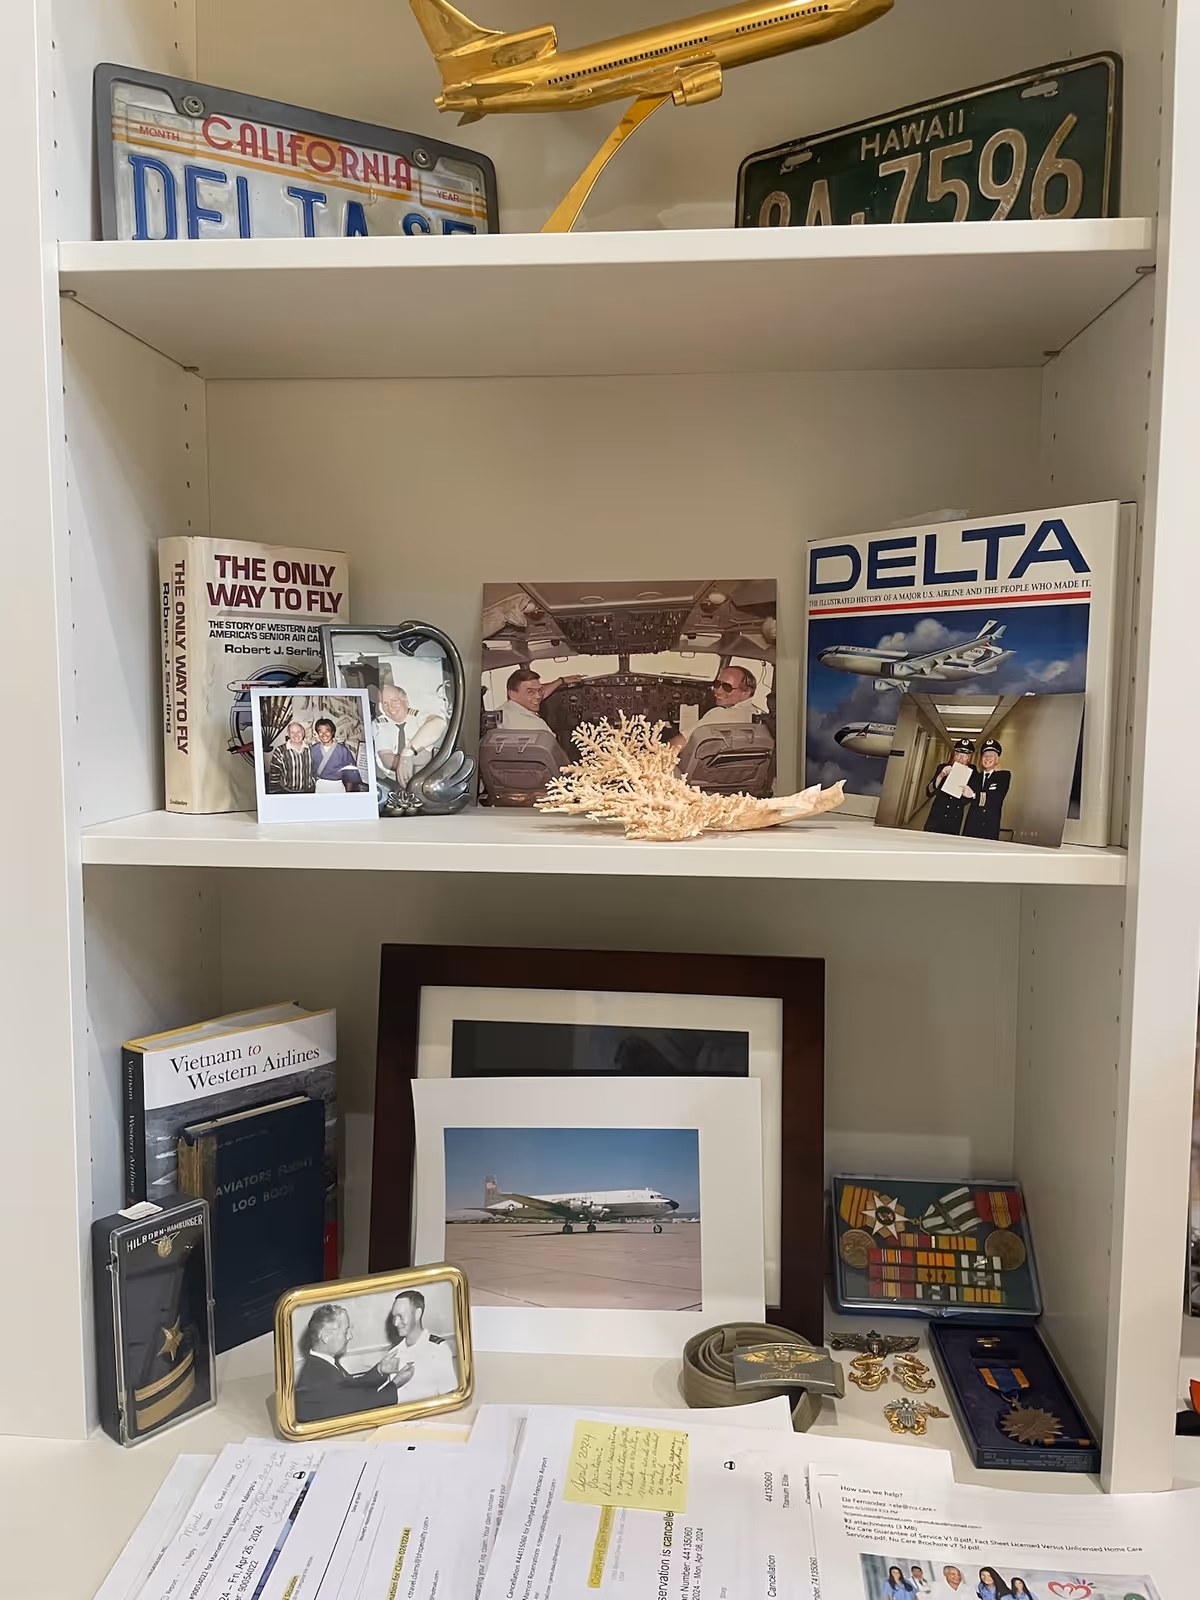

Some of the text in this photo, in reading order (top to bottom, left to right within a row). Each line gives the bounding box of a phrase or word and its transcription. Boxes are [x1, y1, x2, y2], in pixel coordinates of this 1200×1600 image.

[139, 125, 180, 142] MONTH
[860, 109, 964, 161] HAWAII
[202, 116, 413, 191] CALIFORNIA
[436, 190, 461, 203] YEAR
[214, 555, 336, 587] THE ONLY
[809, 519, 1092, 595] DELTA
[206, 582, 343, 613] WAY TO FLY
[819, 597, 856, 606] ILLUSTRATED
[856, 594, 882, 604] HISTORY
[899, 591, 921, 600] MAJOR
[922, 590, 935, 598] U.S.
[936, 588, 964, 597] AIRLINE
[965, 586, 983, 595] AND
[984, 585, 999, 594] THE
[1000, 583, 1030, 593] PEOPLE
[1031, 581, 1053, 591] WHO
[1053, 579, 1079, 589] MADE
[1081, 579, 1092, 588] IT.
[208, 620, 224, 629] THE
[225, 621, 256, 630] STORY
[255, 622, 267, 631] OF
[267, 623, 306, 633] WESTERN
[209, 630, 258, 640] AMERICA'S
[260, 632, 290, 641] SENIOR
[291, 633, 306, 642] AIR
[164, 652, 171, 668] J.
[175, 560, 189, 755] THE ONLY WAY TO FLY
[224, 644, 271, 656] Robert
[273, 646, 284, 656] J.
[169, 1044, 262, 1074] Vietnam to
[187, 1048, 320, 1090] Western Airlines
[129, 1154, 137, 1193] Airlines
[232, 1195, 257, 1213] LOG
[782, 1474, 790, 1486] Elite
[884, 1491, 903, 1499] help?
[506, 1564, 520, 1599] Cancellation
[539, 1457, 548, 1474] Airport
[663, 1510, 674, 1547] cancelle
[695, 1527, 704, 1541] 2024
[764, 1471, 777, 1598] Cancellation 44135060
[853, 1520, 895, 1529] attachments
[873, 1528, 908, 1537] Guarantee
[990, 1539, 1010, 1547] Sheet
[235, 1556, 249, 1570] Apr
[248, 1525, 264, 1542] 2024
[660, 1548, 671, 1558] is
[682, 1527, 693, 1561] 44135060
[694, 1552, 704, 1564] Apr
[237, 1560, 259, 1593] 90054022
[391, 1572, 400, 1582] for
[394, 1555, 405, 1572] Claim
[680, 1562, 691, 1592] Number:
[810, 1556, 820, 1586] 74135060
